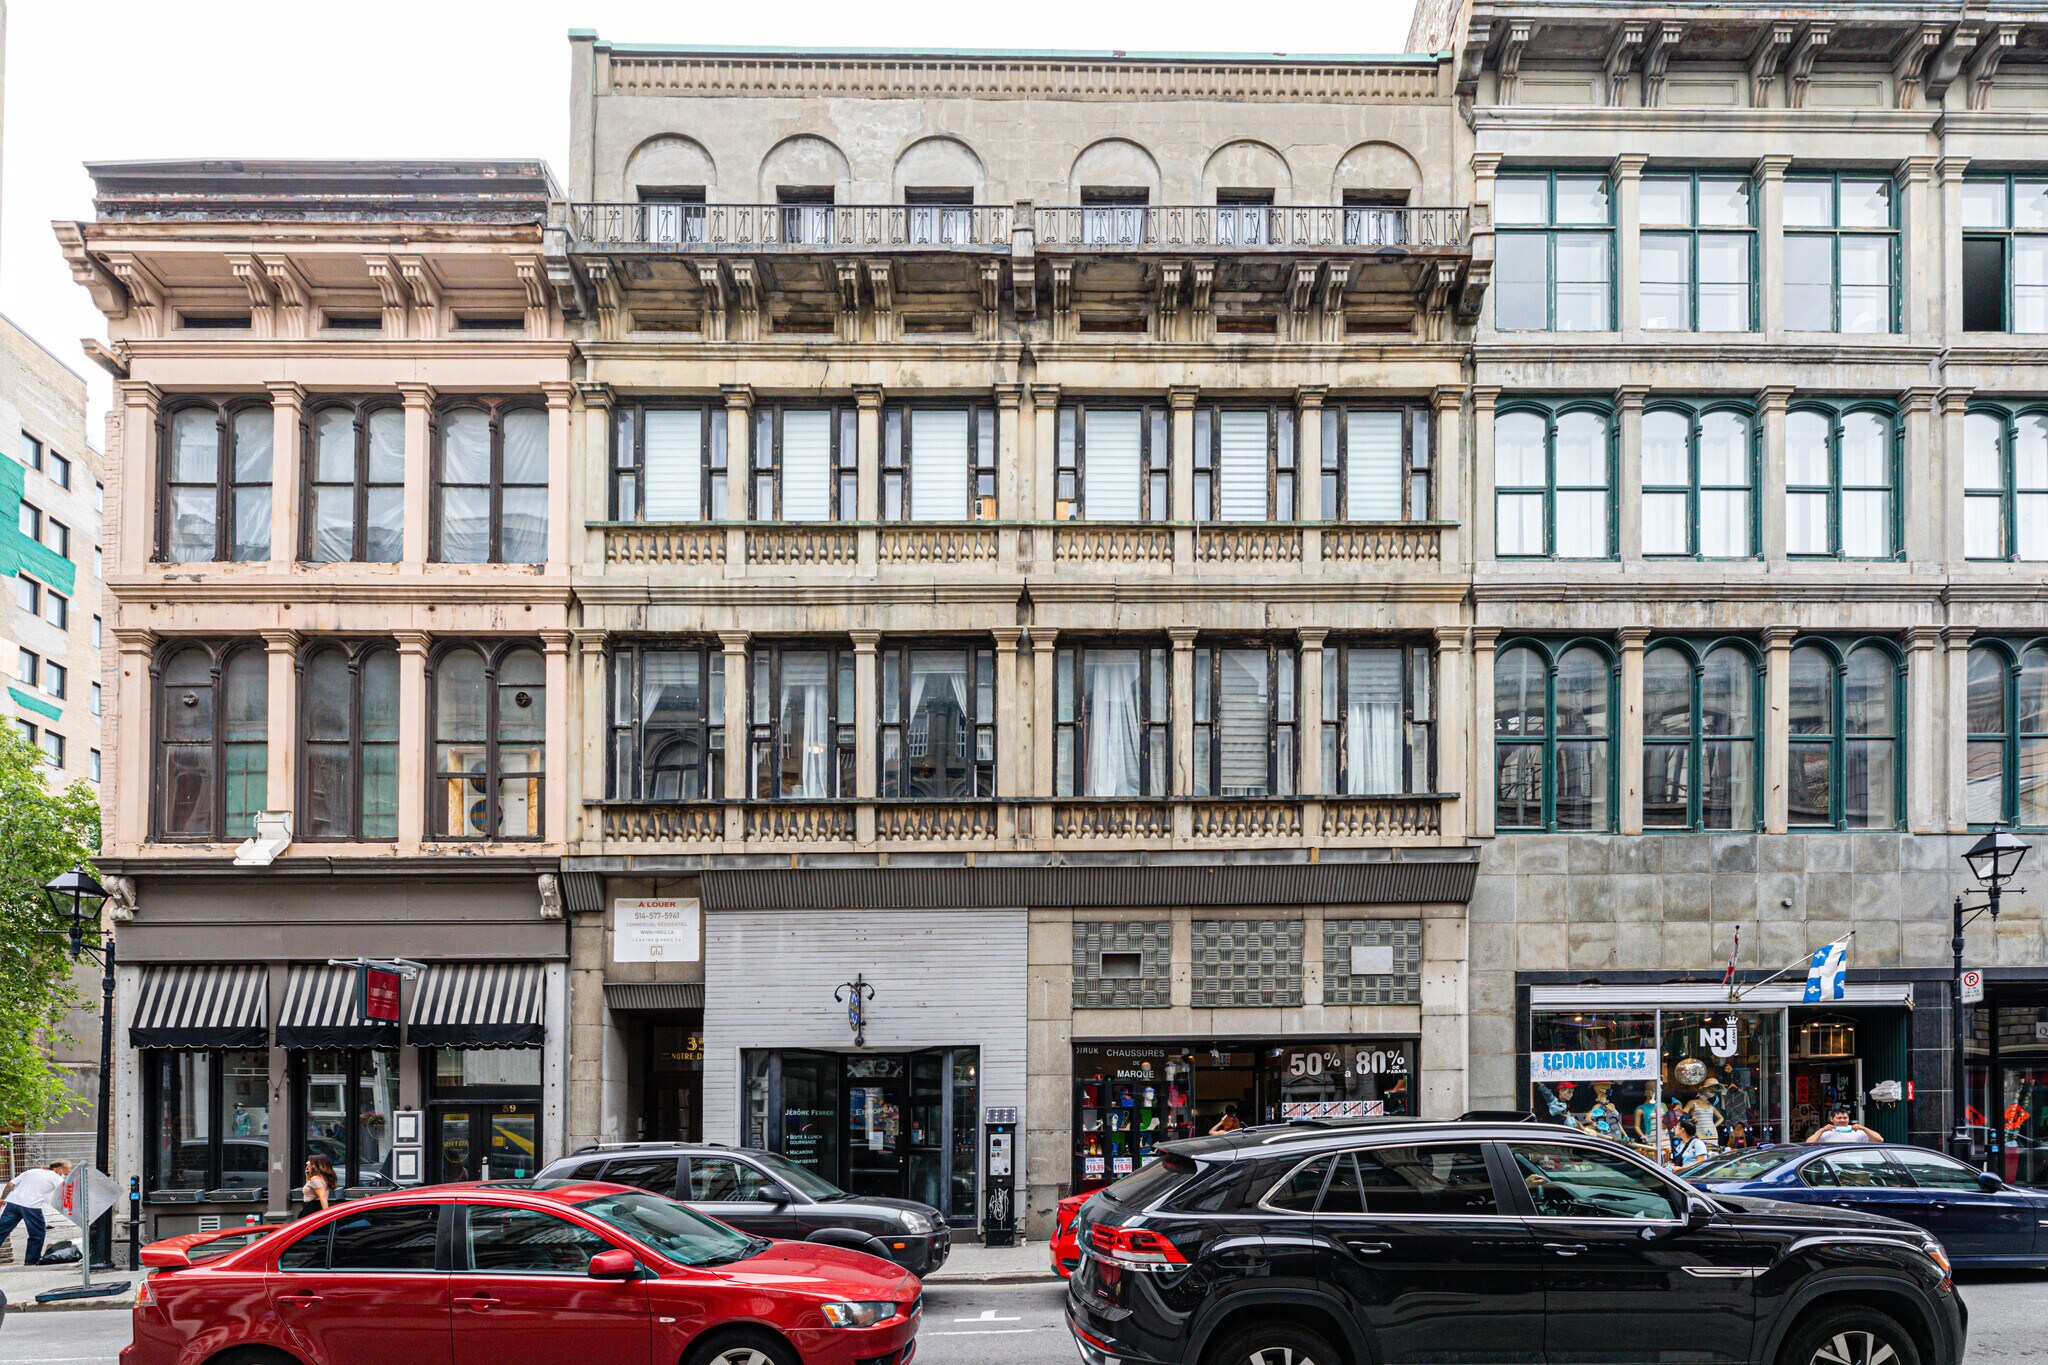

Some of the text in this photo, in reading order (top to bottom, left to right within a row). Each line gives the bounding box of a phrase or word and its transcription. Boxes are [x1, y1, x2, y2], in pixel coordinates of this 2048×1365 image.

[634, 912, 680, 920] 514-577-5941
[1699, 1028, 1738, 1058] NRJ
[1106, 1049, 1165, 1057] CHAUSSURES
[1290, 1052, 1341, 1076] 50%
[1355, 1050, 1405, 1075] 80%
[1543, 1052, 1646, 1070] ECONOMISEZ
[1117, 1069, 1155, 1079] MARQUE
[502, 1104, 517, 1113] 39
